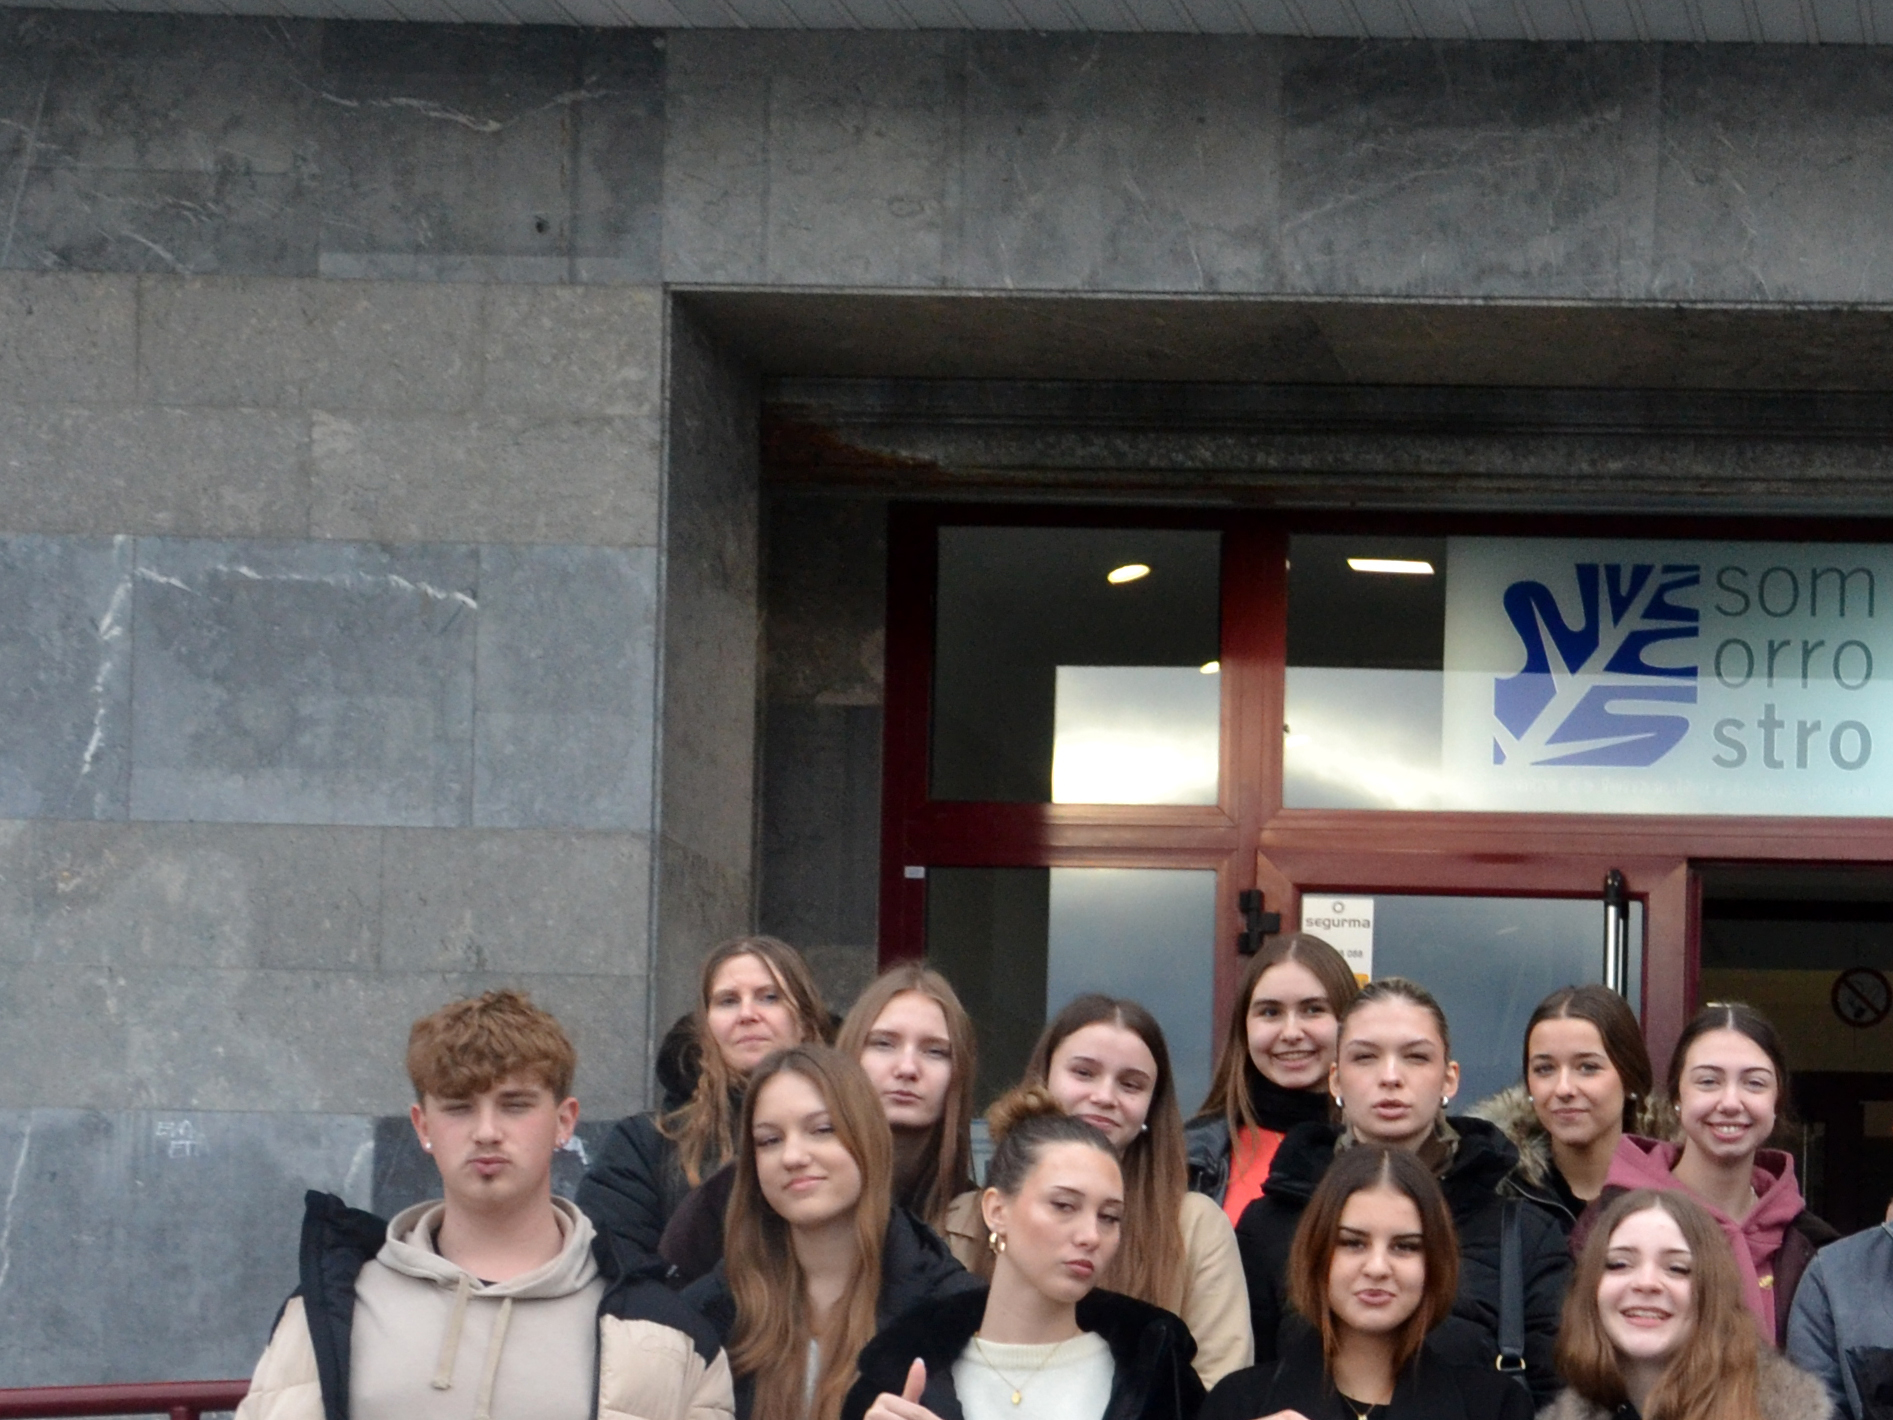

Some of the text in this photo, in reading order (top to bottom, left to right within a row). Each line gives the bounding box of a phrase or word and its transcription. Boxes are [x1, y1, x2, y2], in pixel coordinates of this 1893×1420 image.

[1713, 564, 1877, 618] som
[1713, 637, 1875, 691] orro
[1711, 701, 1873, 771] stro
[1305, 917, 1371, 930] segurma
